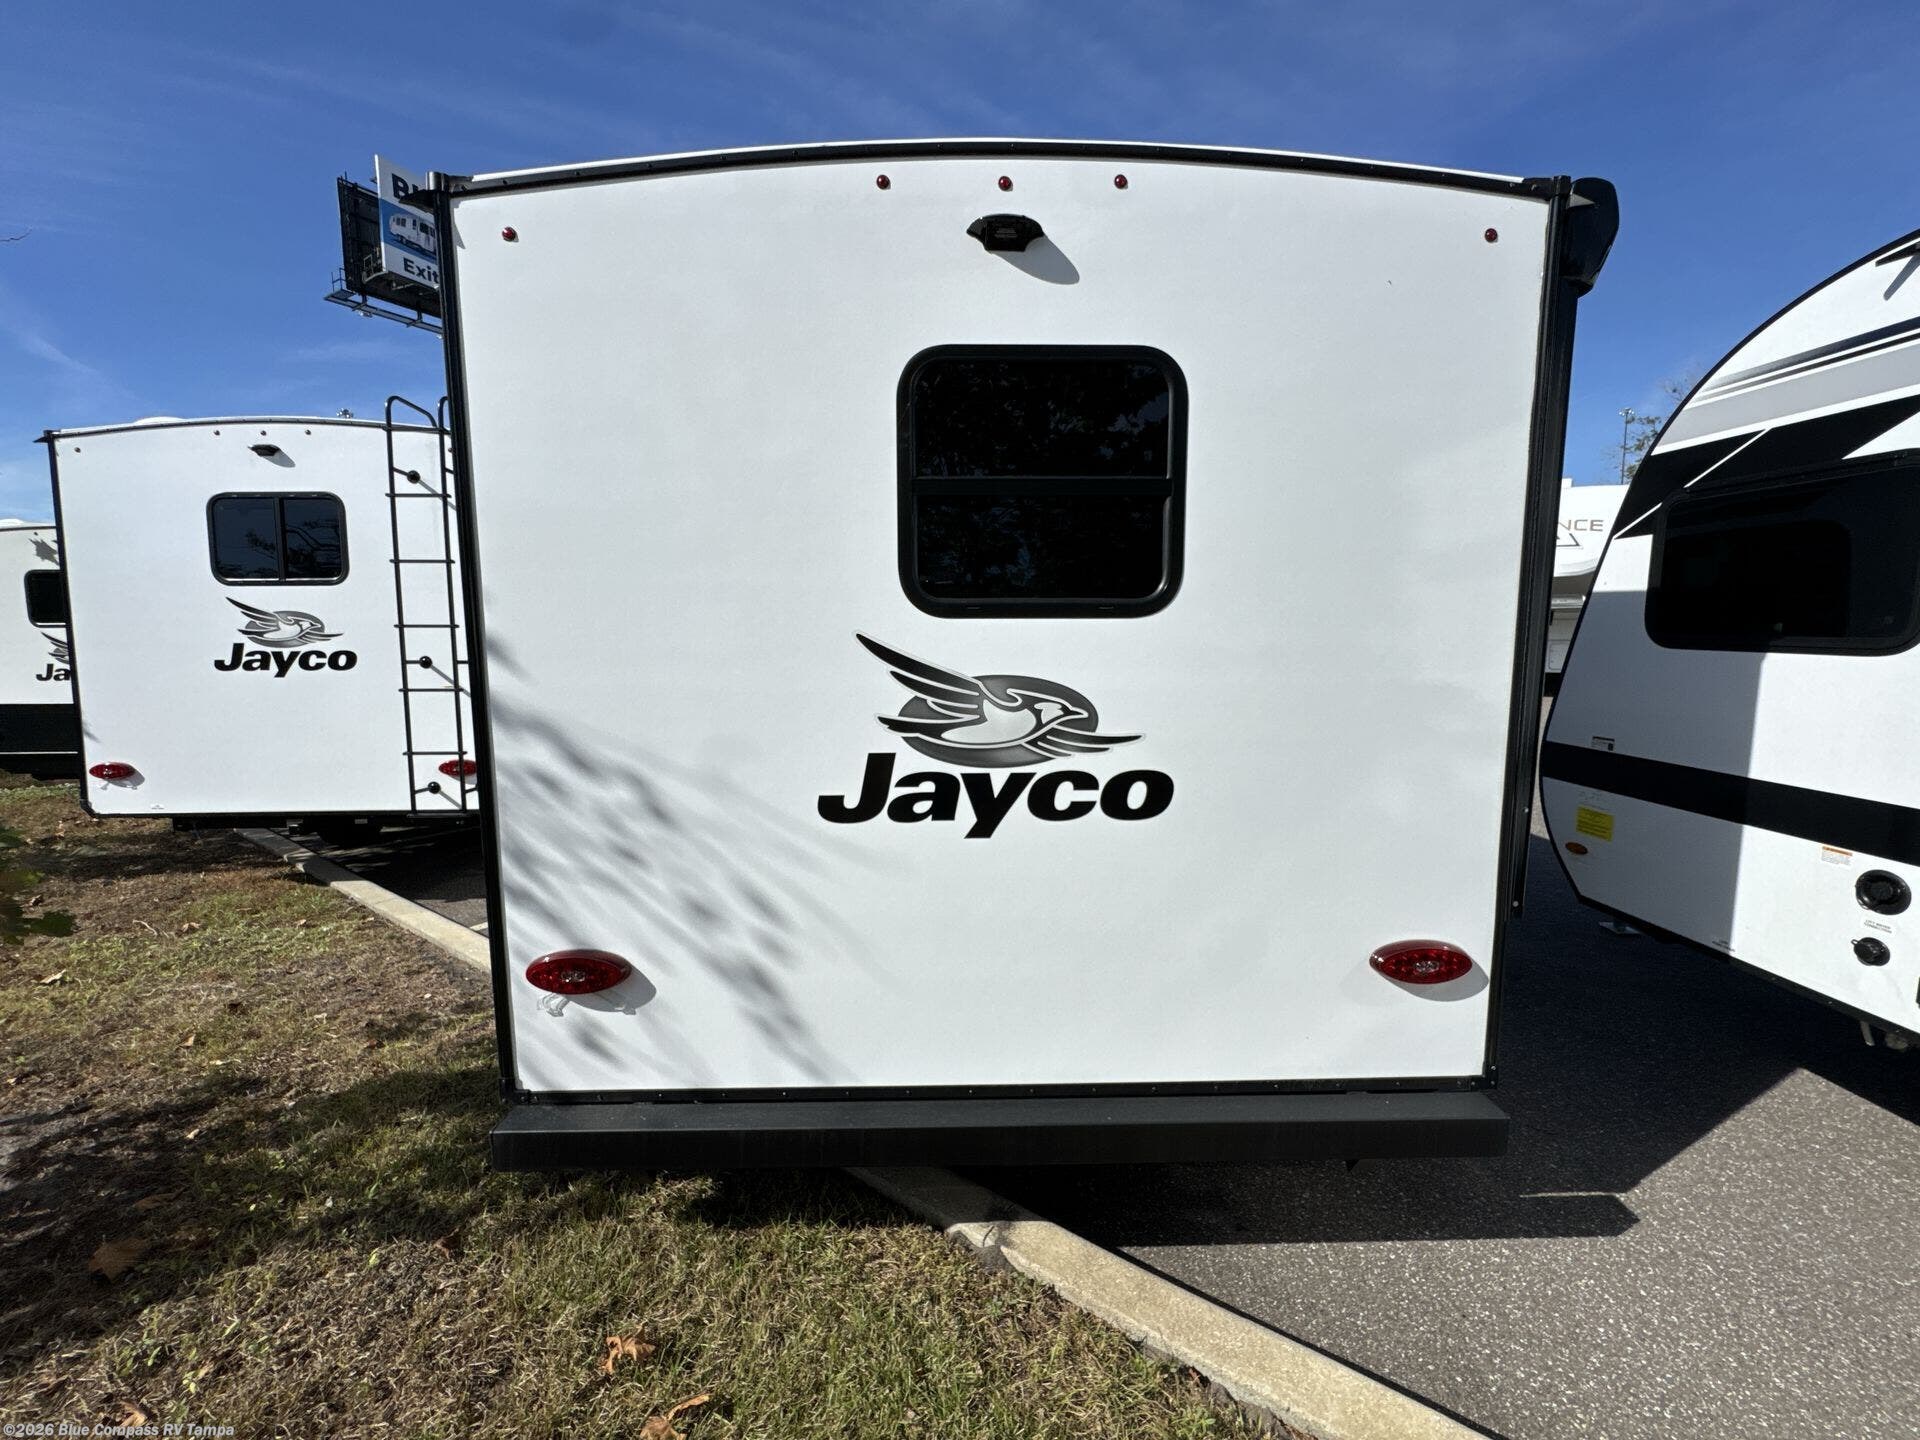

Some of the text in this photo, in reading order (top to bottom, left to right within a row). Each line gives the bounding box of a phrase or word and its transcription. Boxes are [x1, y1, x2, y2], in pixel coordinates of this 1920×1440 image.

[391, 172, 419, 200] B
[403, 256, 439, 284] Exit
[35, 663, 71, 681] Ja
[213, 642, 358, 678] Jayco
[817, 752, 1175, 839] Jayco
